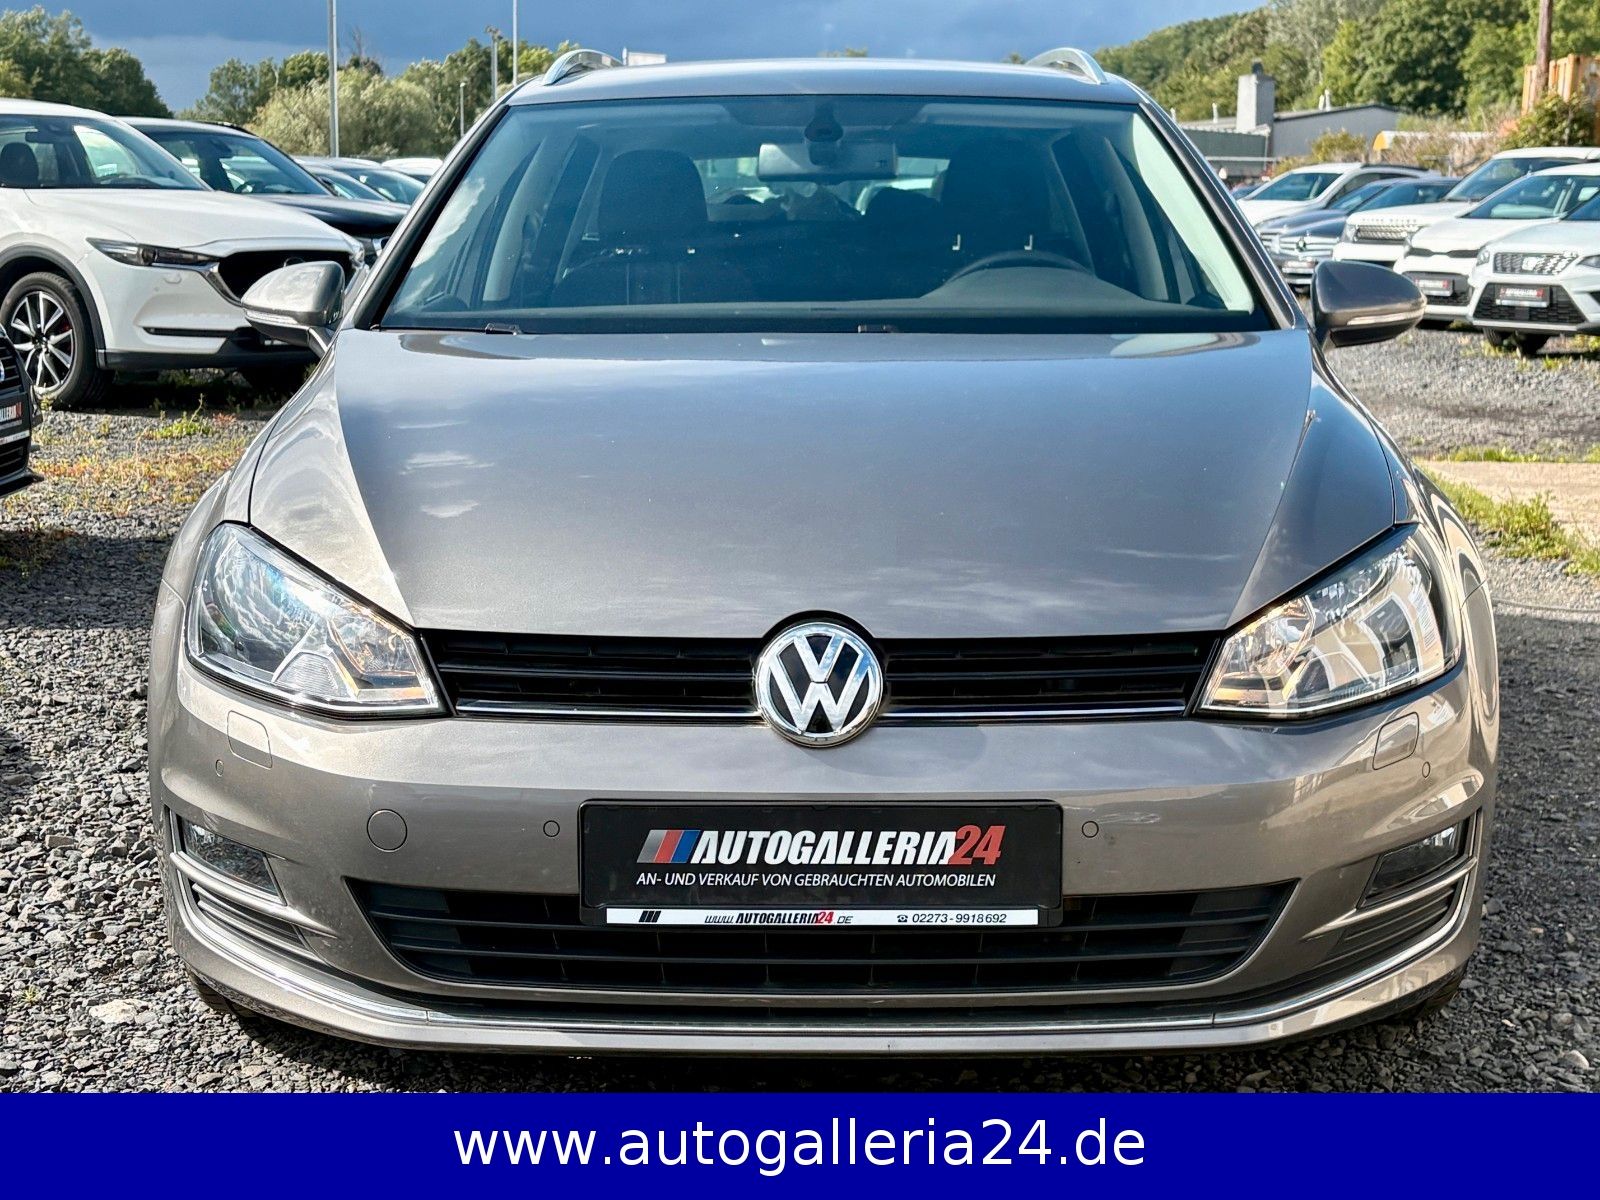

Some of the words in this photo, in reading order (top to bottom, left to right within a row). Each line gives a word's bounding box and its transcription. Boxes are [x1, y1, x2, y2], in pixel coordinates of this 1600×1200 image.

[764, 628, 874, 736] VW
[690, 825, 1006, 865] AUTOGALLERIA24
[636, 872, 661, 886] AN-
[665, 872, 696, 886] UND
[698, 872, 759, 886] VERKAUF
[761, 873, 793, 887] VON
[795, 873, 893, 887] GEBRAUCHTEN
[896, 873, 996, 887] AUTOMOBILEN
[911, 912, 1007, 924] 02273-9918692
